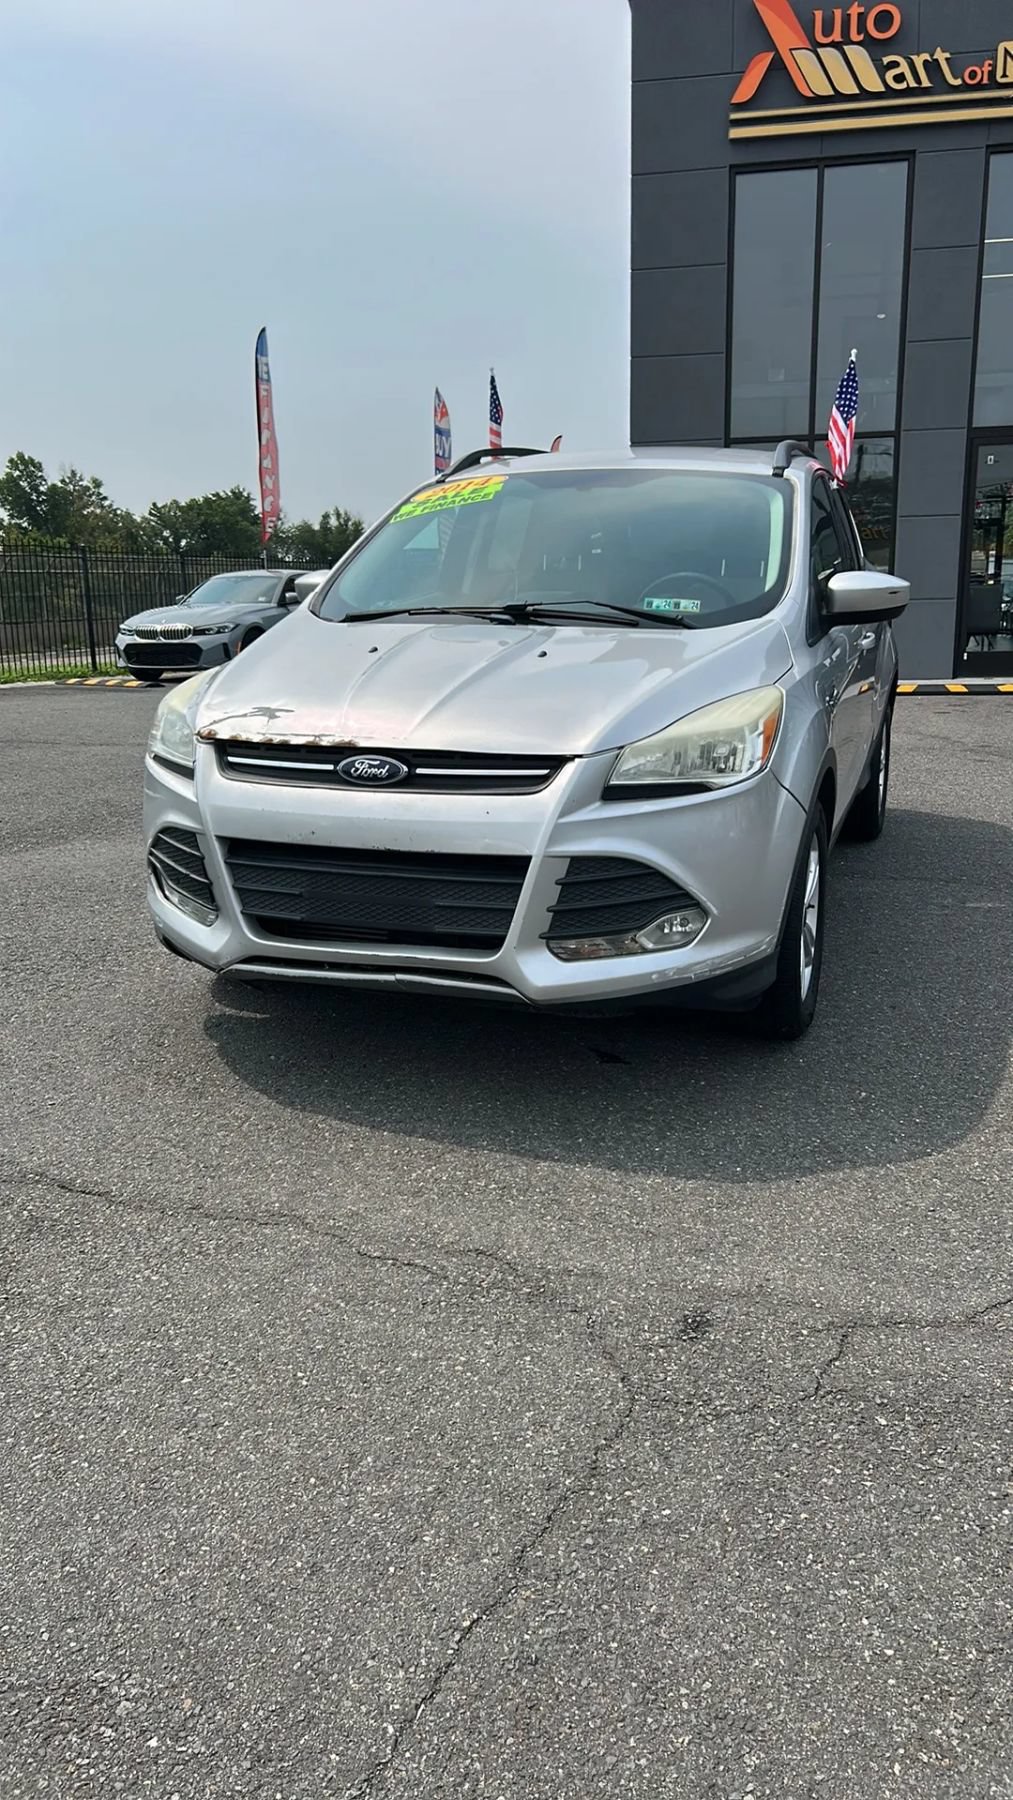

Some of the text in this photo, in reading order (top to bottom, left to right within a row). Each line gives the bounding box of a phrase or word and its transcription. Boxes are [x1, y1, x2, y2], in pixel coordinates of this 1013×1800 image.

[963, 60, 993, 85] of
[412, 487, 487, 508] SALE
[426, 477, 493, 498] 2014
[393, 493, 492, 521] WE FINANCE
[351, 759, 389, 778] Ford
